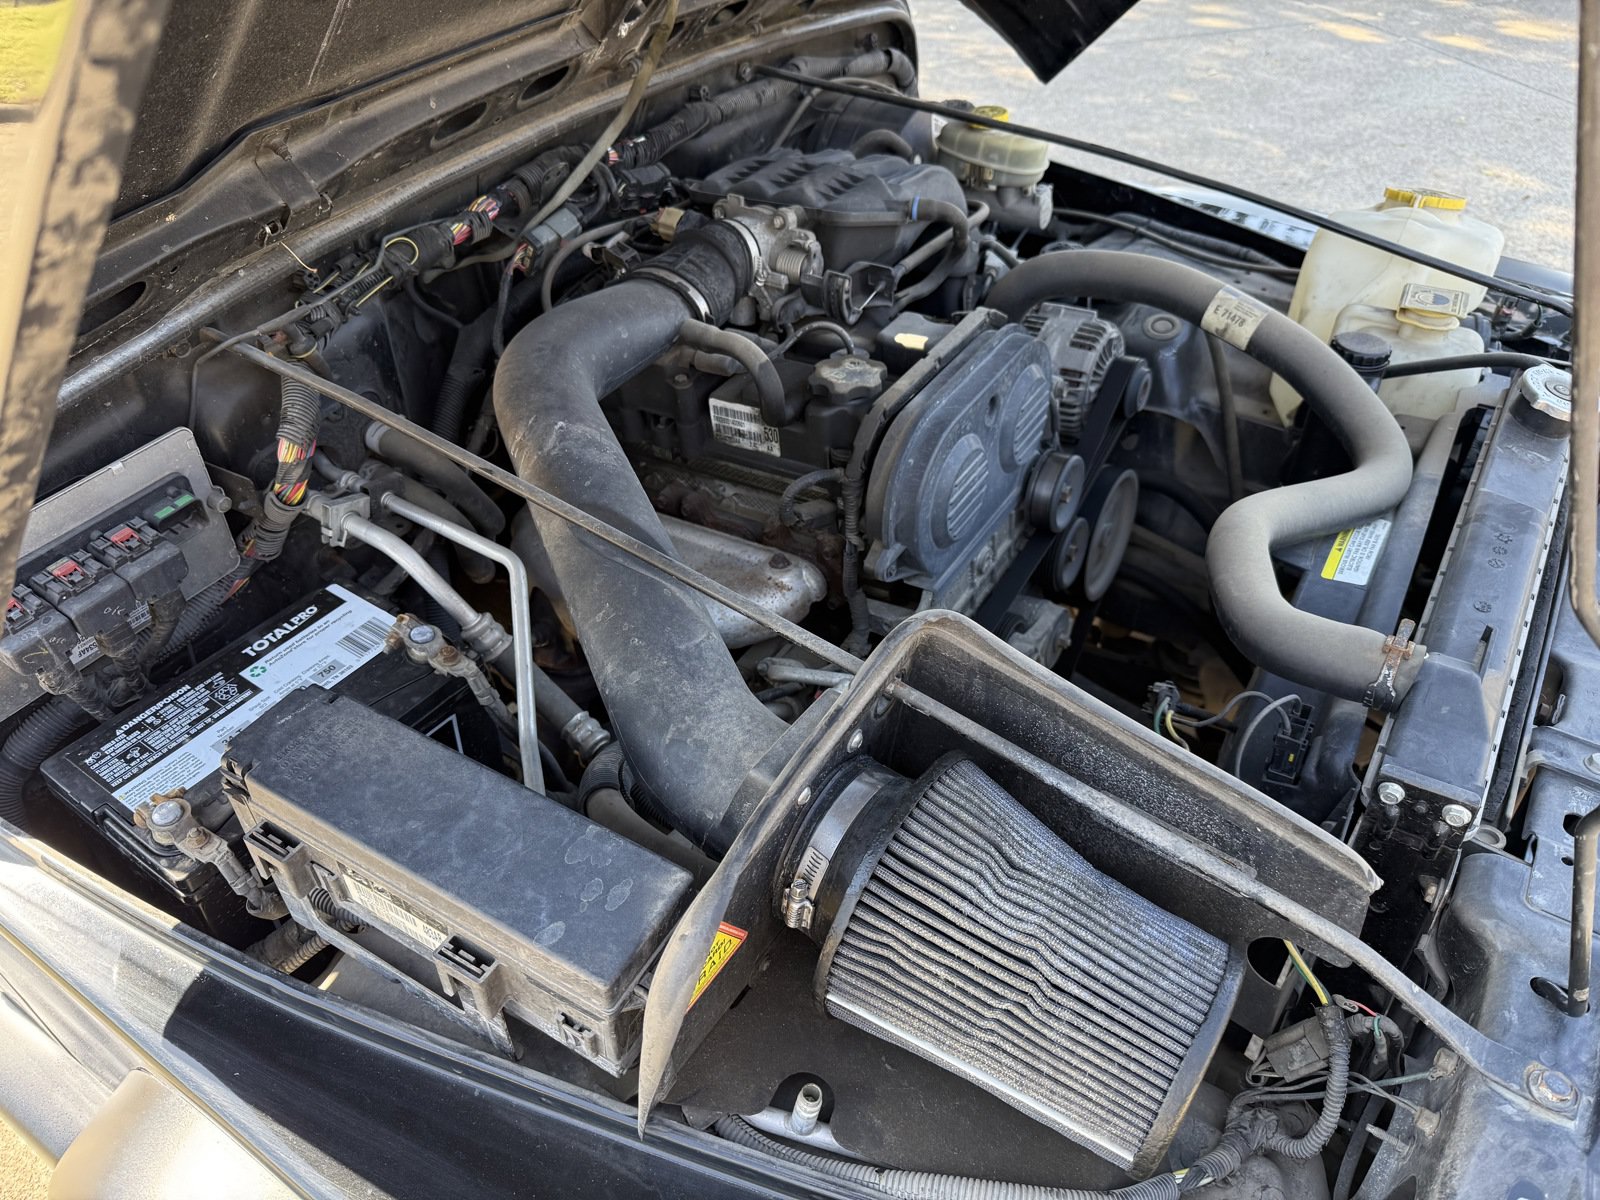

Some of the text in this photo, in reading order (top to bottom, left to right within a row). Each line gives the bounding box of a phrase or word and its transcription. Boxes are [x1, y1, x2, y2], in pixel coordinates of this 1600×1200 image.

[241, 605, 318, 658] TOTALPRO
[316, 664, 337, 678] 750
[120, 683, 192, 731] DANGER/POISON
[698, 938, 732, 984] RAID
